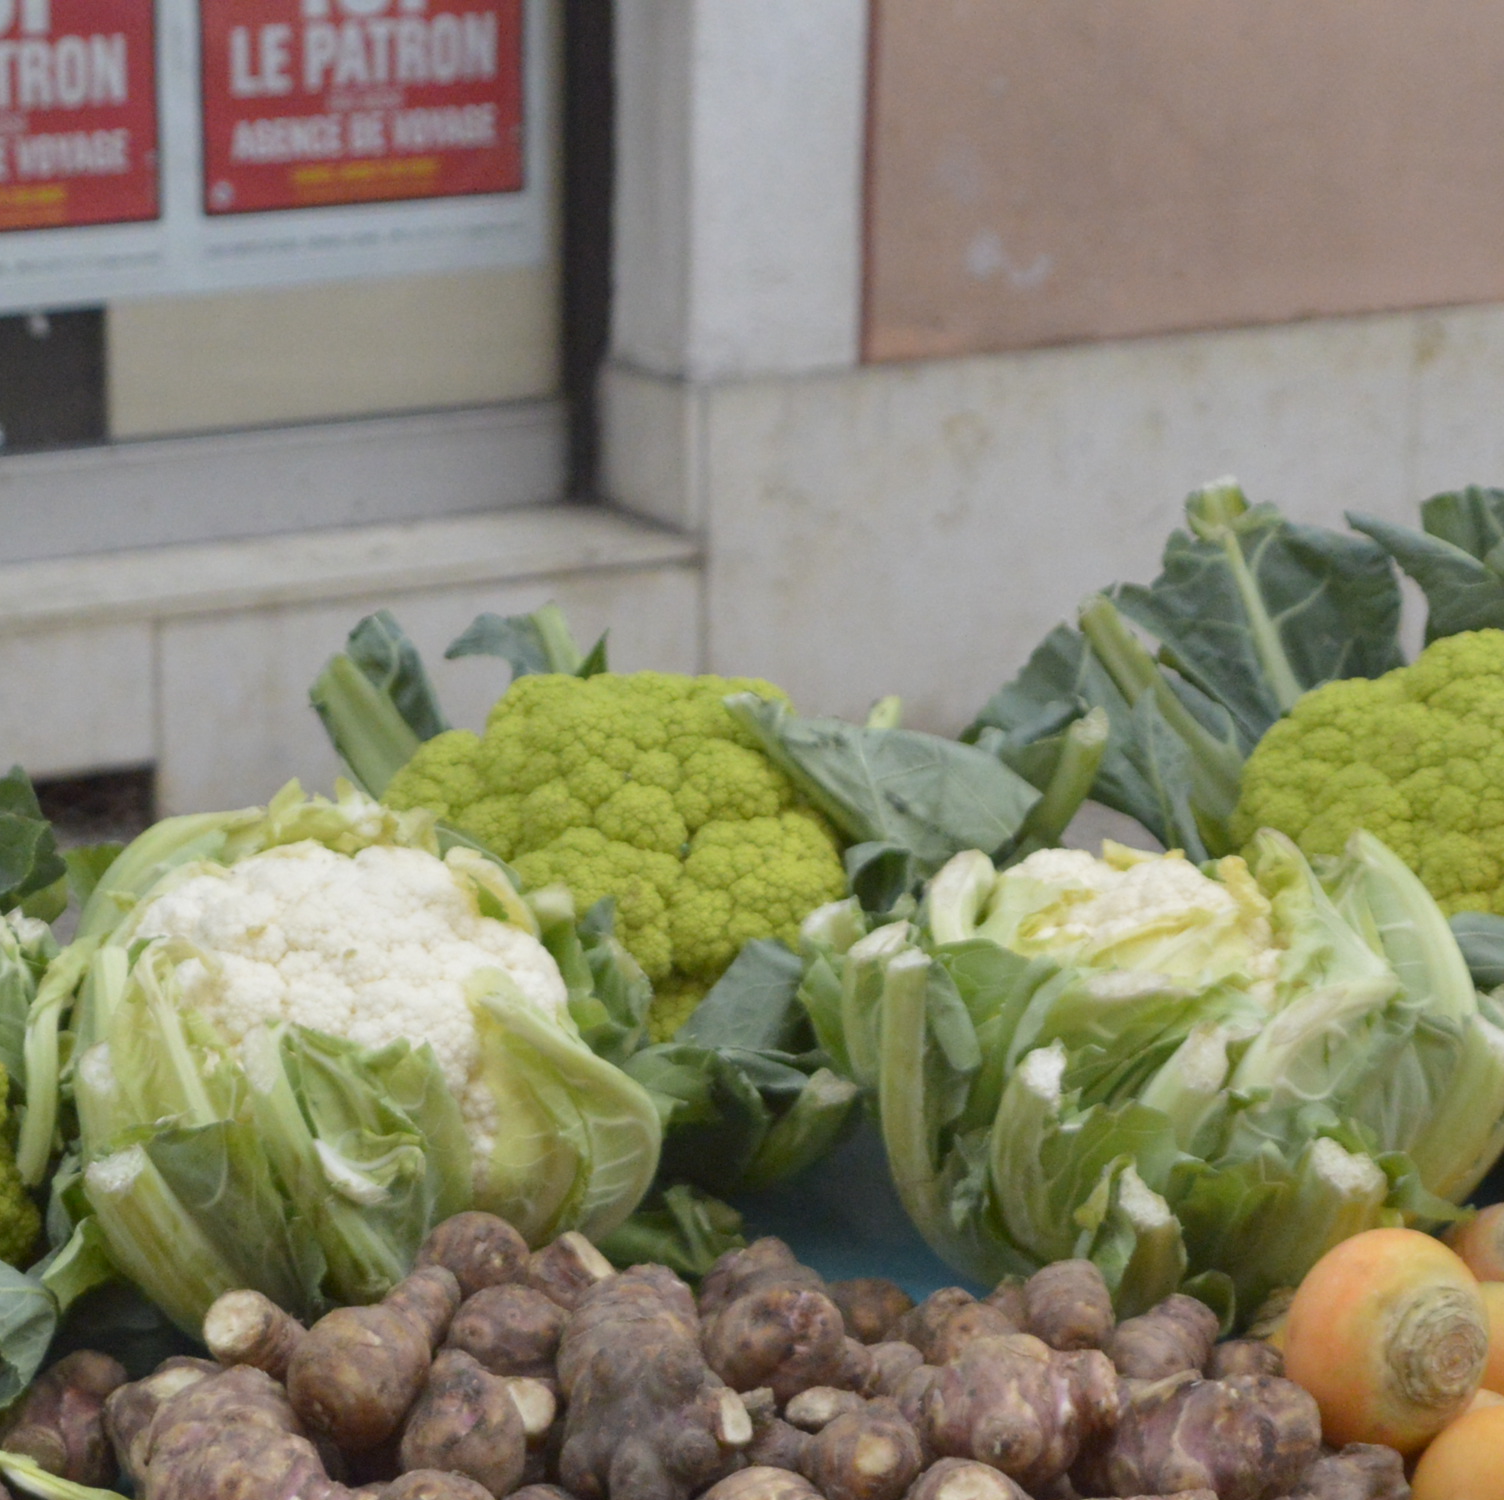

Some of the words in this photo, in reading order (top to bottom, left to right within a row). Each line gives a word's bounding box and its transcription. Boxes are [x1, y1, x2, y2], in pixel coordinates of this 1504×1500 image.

[228, 22, 293, 98] LE
[302, 10, 496, 94] PATRON
[14, 128, 130, 181] VOYAGE
[230, 112, 344, 164] AGENCE
[348, 110, 386, 158] DE
